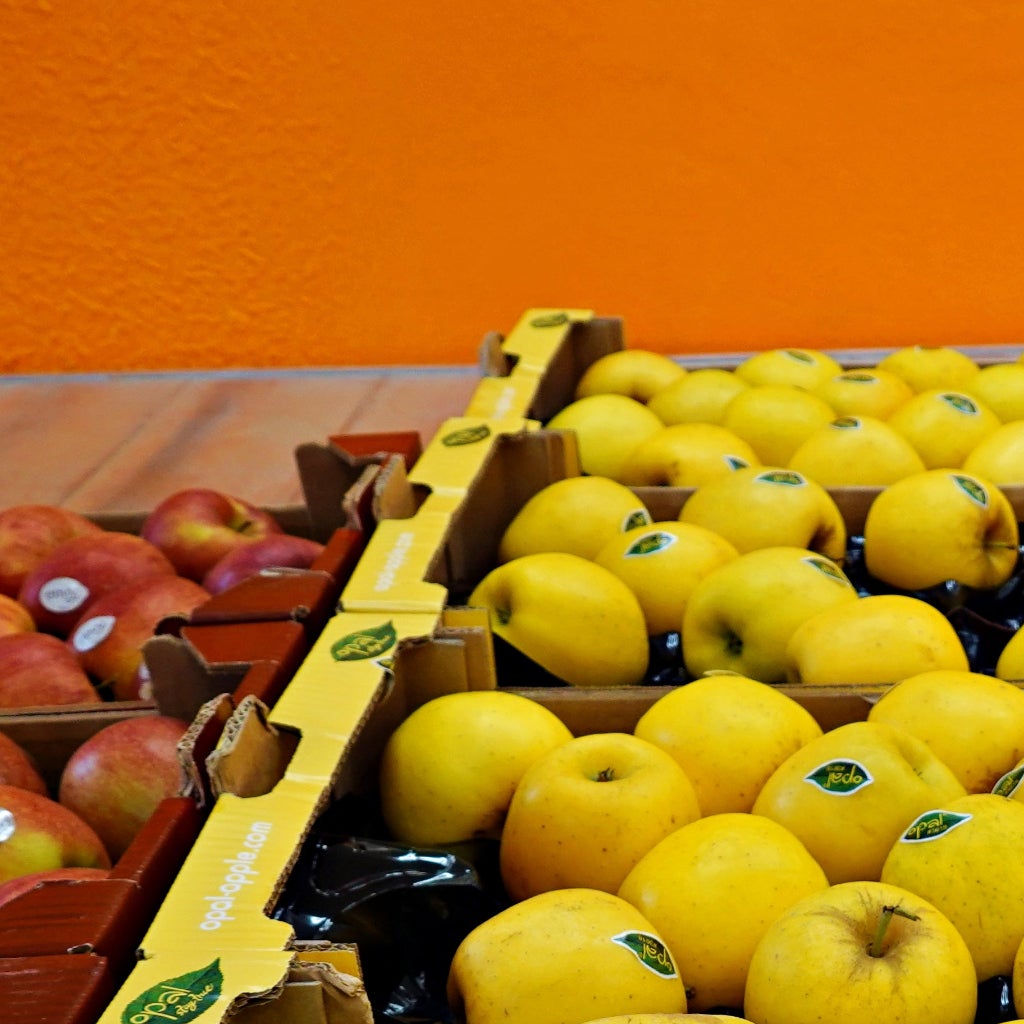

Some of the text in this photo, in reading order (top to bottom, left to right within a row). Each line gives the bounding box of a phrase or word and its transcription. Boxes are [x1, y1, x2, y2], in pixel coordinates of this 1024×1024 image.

[828, 765, 863, 788] opal
[908, 813, 944, 839] opal
[199, 821, 273, 931] opal-apple.com
[643, 943, 673, 972] opal
[129, 985, 191, 1024] opal
